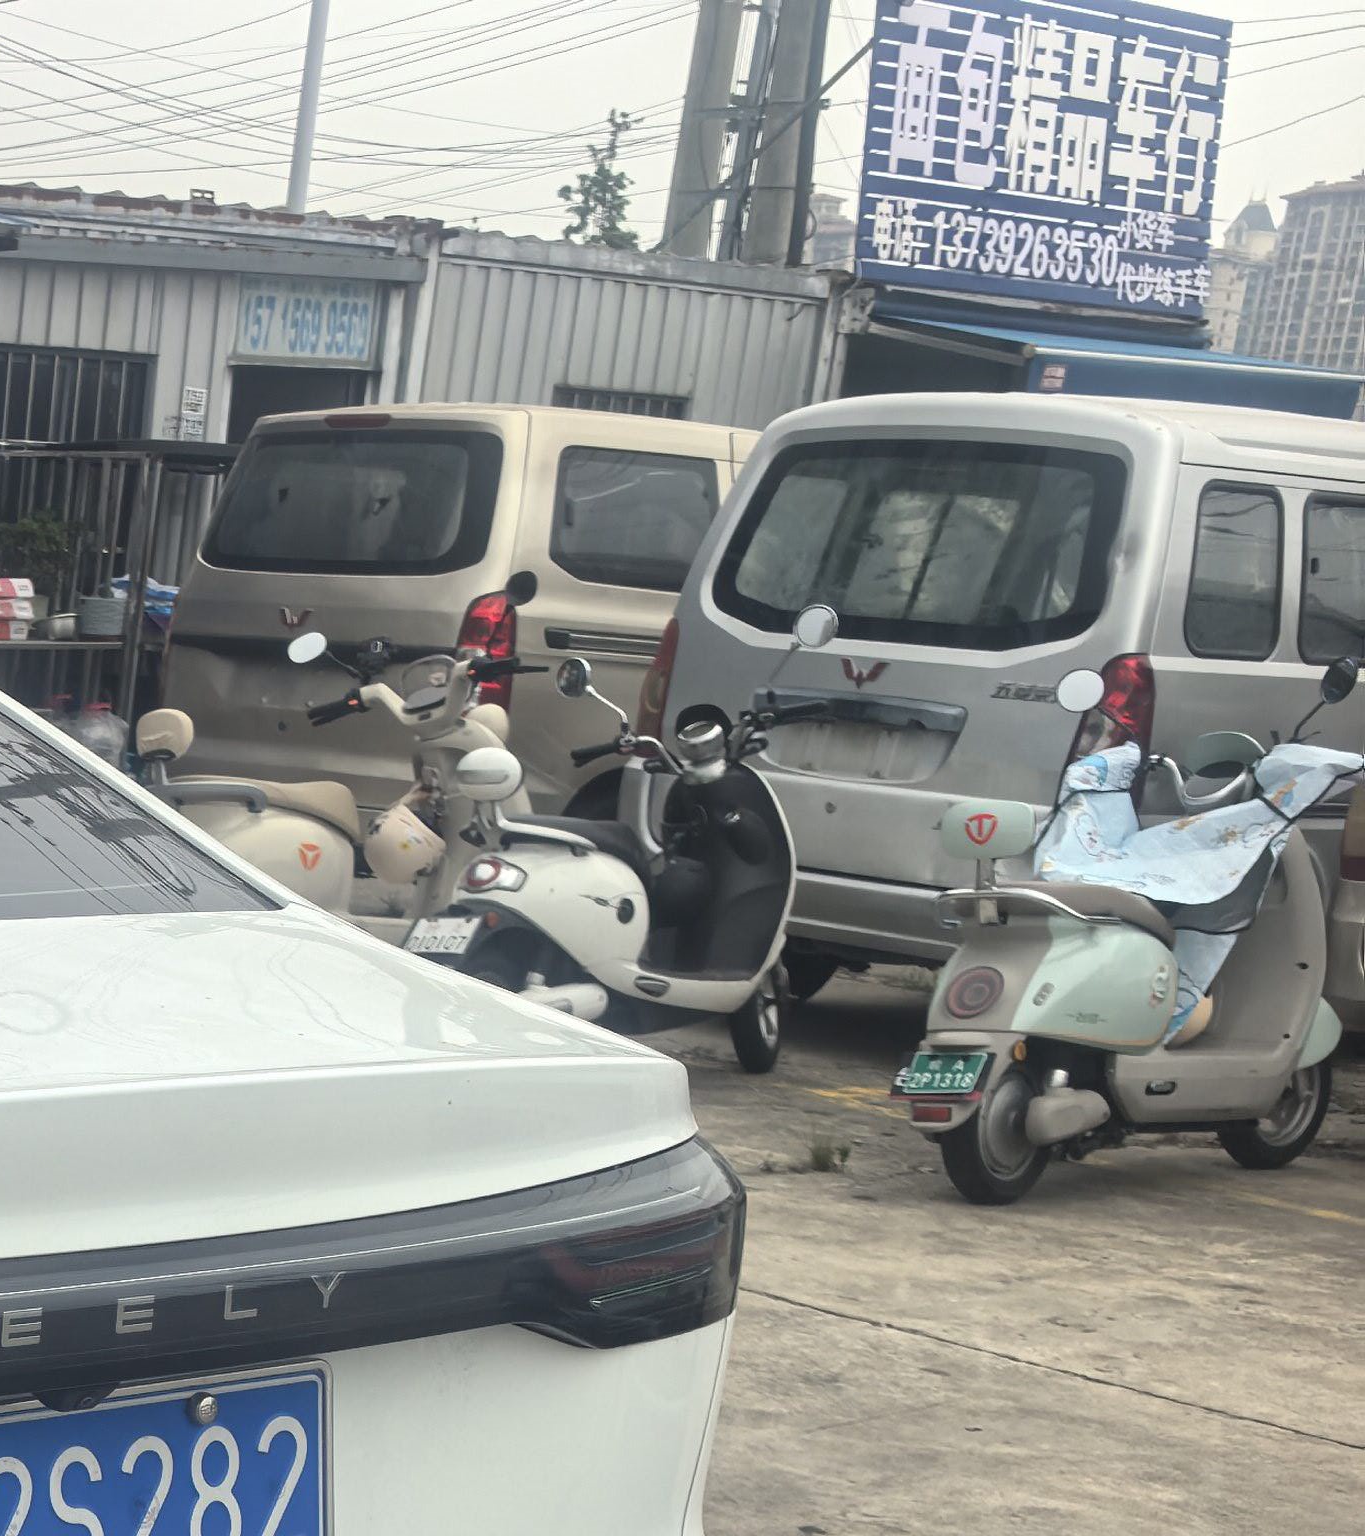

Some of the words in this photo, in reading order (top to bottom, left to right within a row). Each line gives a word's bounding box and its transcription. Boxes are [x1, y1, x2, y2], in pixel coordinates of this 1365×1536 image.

[932, 210, 1119, 287] 13739263530
[1119, 210, 1177, 252] 小货车
